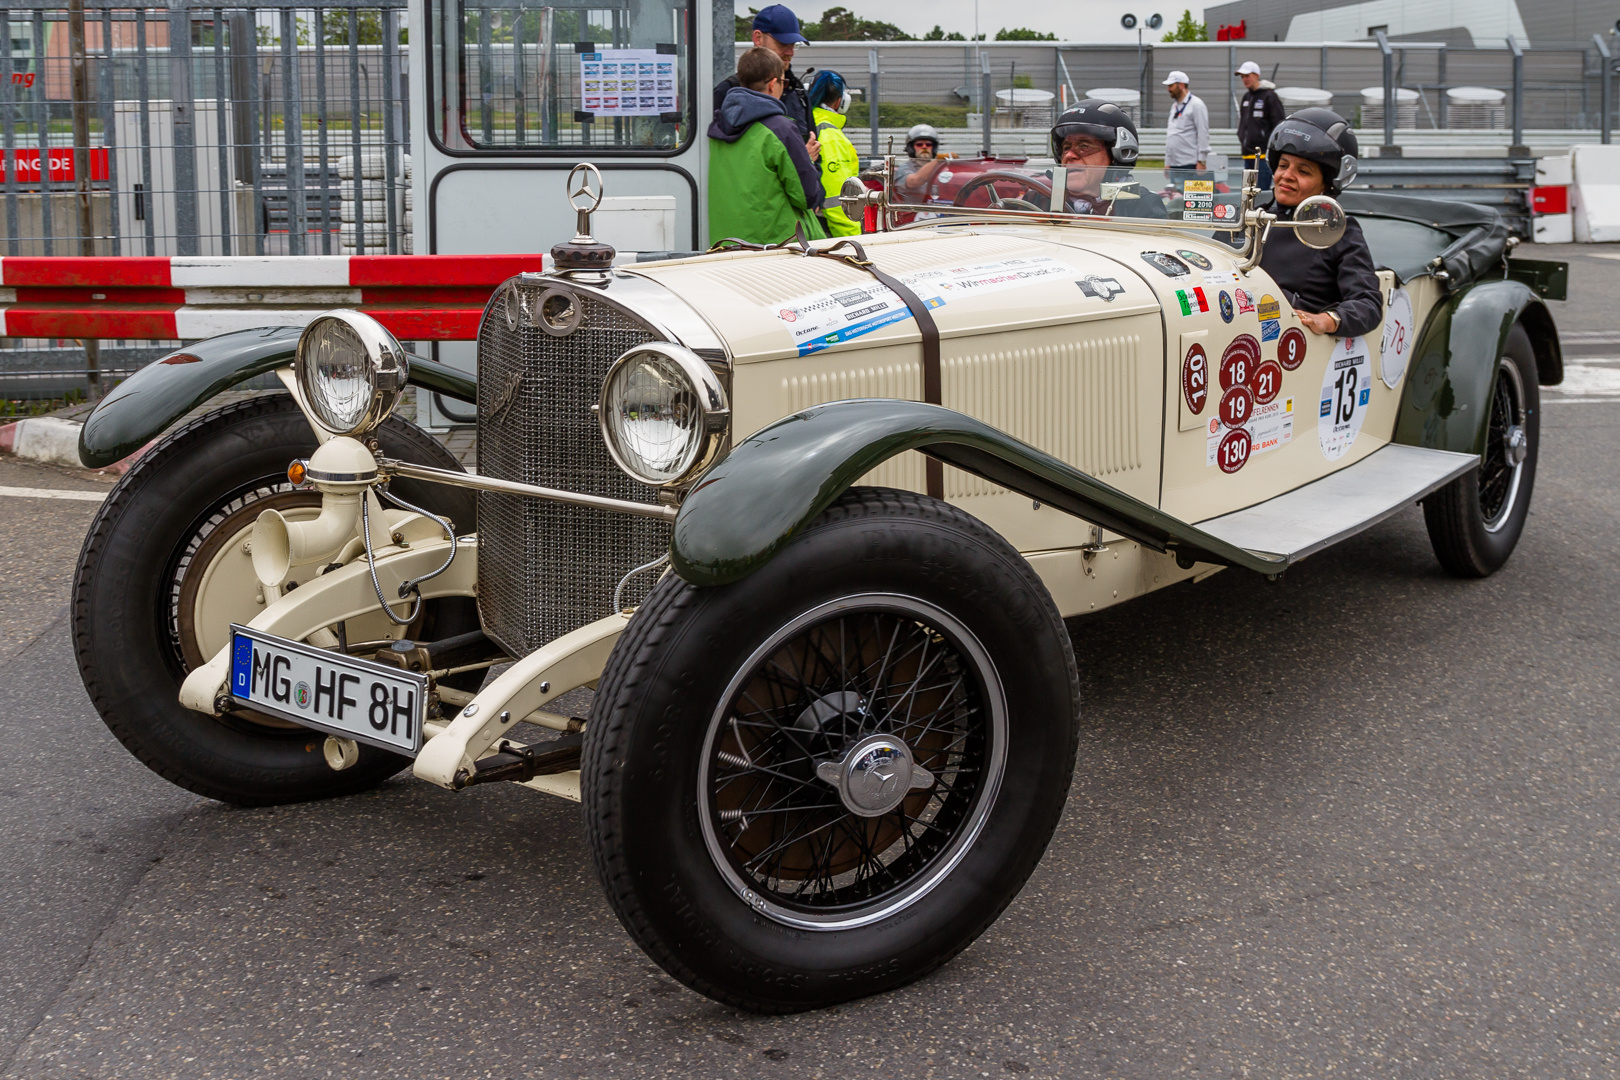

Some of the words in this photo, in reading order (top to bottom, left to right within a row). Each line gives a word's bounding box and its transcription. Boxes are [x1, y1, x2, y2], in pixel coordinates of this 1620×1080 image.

[1284, 128, 1311, 142] caberg
[956, 267, 1066, 289] WirmachenDruck.de
[1178, 292, 1200, 300] Scuderia
[1182, 300, 1205, 309] Topolino
[846, 309, 870, 320] RICHARD
[871, 303, 887, 311] MILLE
[796, 326, 819, 336] Octane
[1390, 319, 1405, 355] 78
[1289, 339, 1296, 360] 9
[1229, 361, 1245, 385] 18
[1334, 359, 1351, 369] RICHARD
[1352, 356, 1364, 365] MILLE
[1190, 354, 1204, 403] 120
[1259, 371, 1273, 395] 21
[1335, 367, 1357, 425] 13
[1229, 396, 1245, 419] 19
[1250, 403, 1279, 417] IFELRENNEN
[1224, 438, 1247, 464] 130
[1262, 438, 1278, 448] BANK
[238, 672, 245, 686] D
[252, 648, 291, 704] MG
[314, 666, 360, 720] HF
[369, 682, 414, 740] 8H
